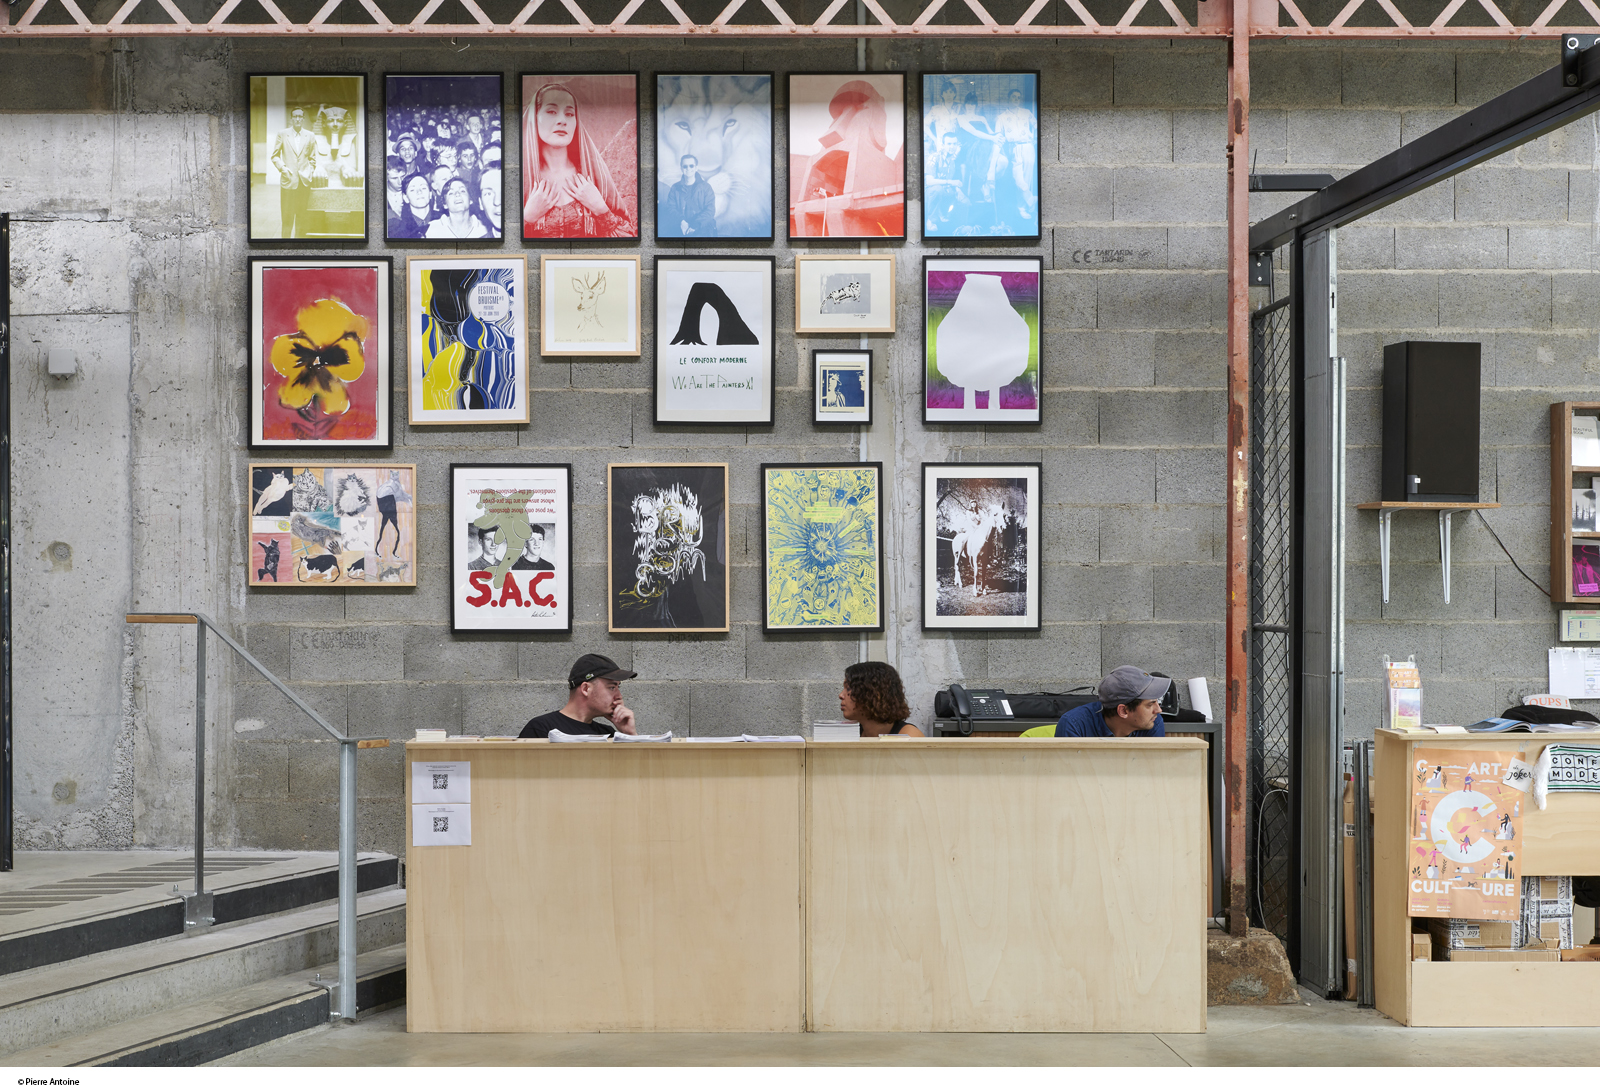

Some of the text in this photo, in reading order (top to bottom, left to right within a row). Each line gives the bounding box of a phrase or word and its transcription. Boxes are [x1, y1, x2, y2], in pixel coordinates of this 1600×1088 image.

[477, 286, 499, 294] FESTIVAL
[679, 357, 687, 365] LE
[690, 356, 717, 364] CONFORT
[466, 571, 557, 608] S.A.C.
[1529, 697, 1562, 706] OUPS
[1468, 761, 1502, 776] ART
[1506, 768, 1533, 781] joker
[1411, 879, 1514, 897] CULT URE
